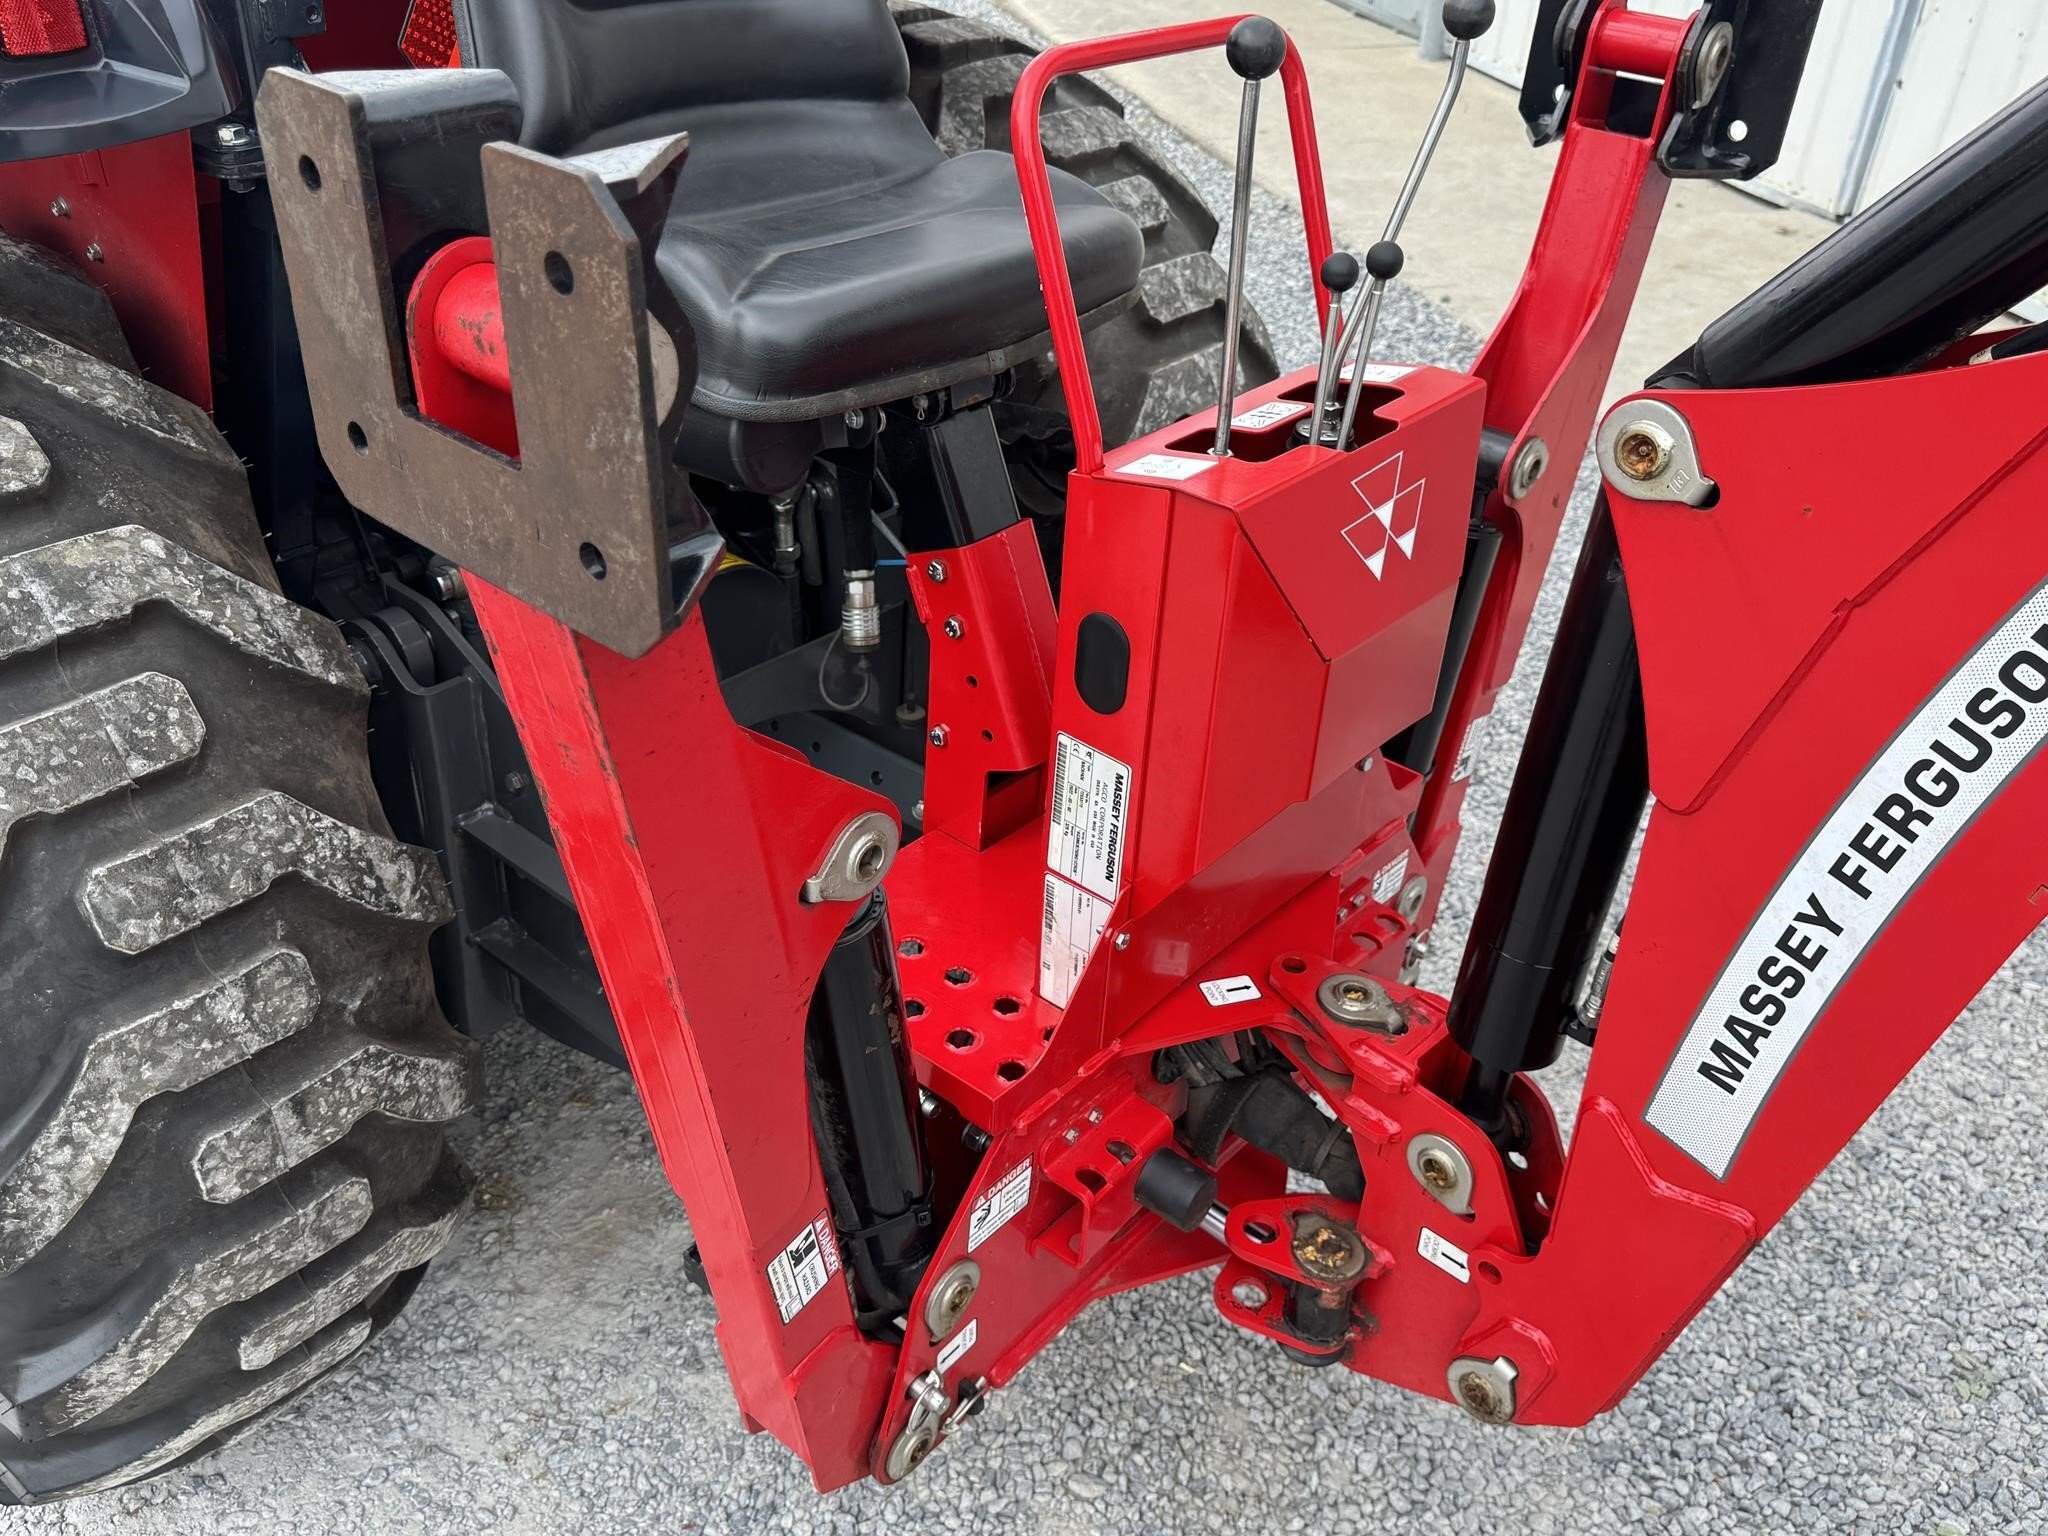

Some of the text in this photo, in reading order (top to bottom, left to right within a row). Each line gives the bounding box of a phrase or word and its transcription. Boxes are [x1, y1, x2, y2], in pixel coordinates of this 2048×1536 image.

[1095, 807, 1106, 861] CORPORATION
[1105, 773, 1124, 882] MASSEY FERGUSON
[1697, 892, 1844, 1096] MASSEY
[988, 1158, 1030, 1199] DANGER
[818, 1228, 838, 1274] DANGER
